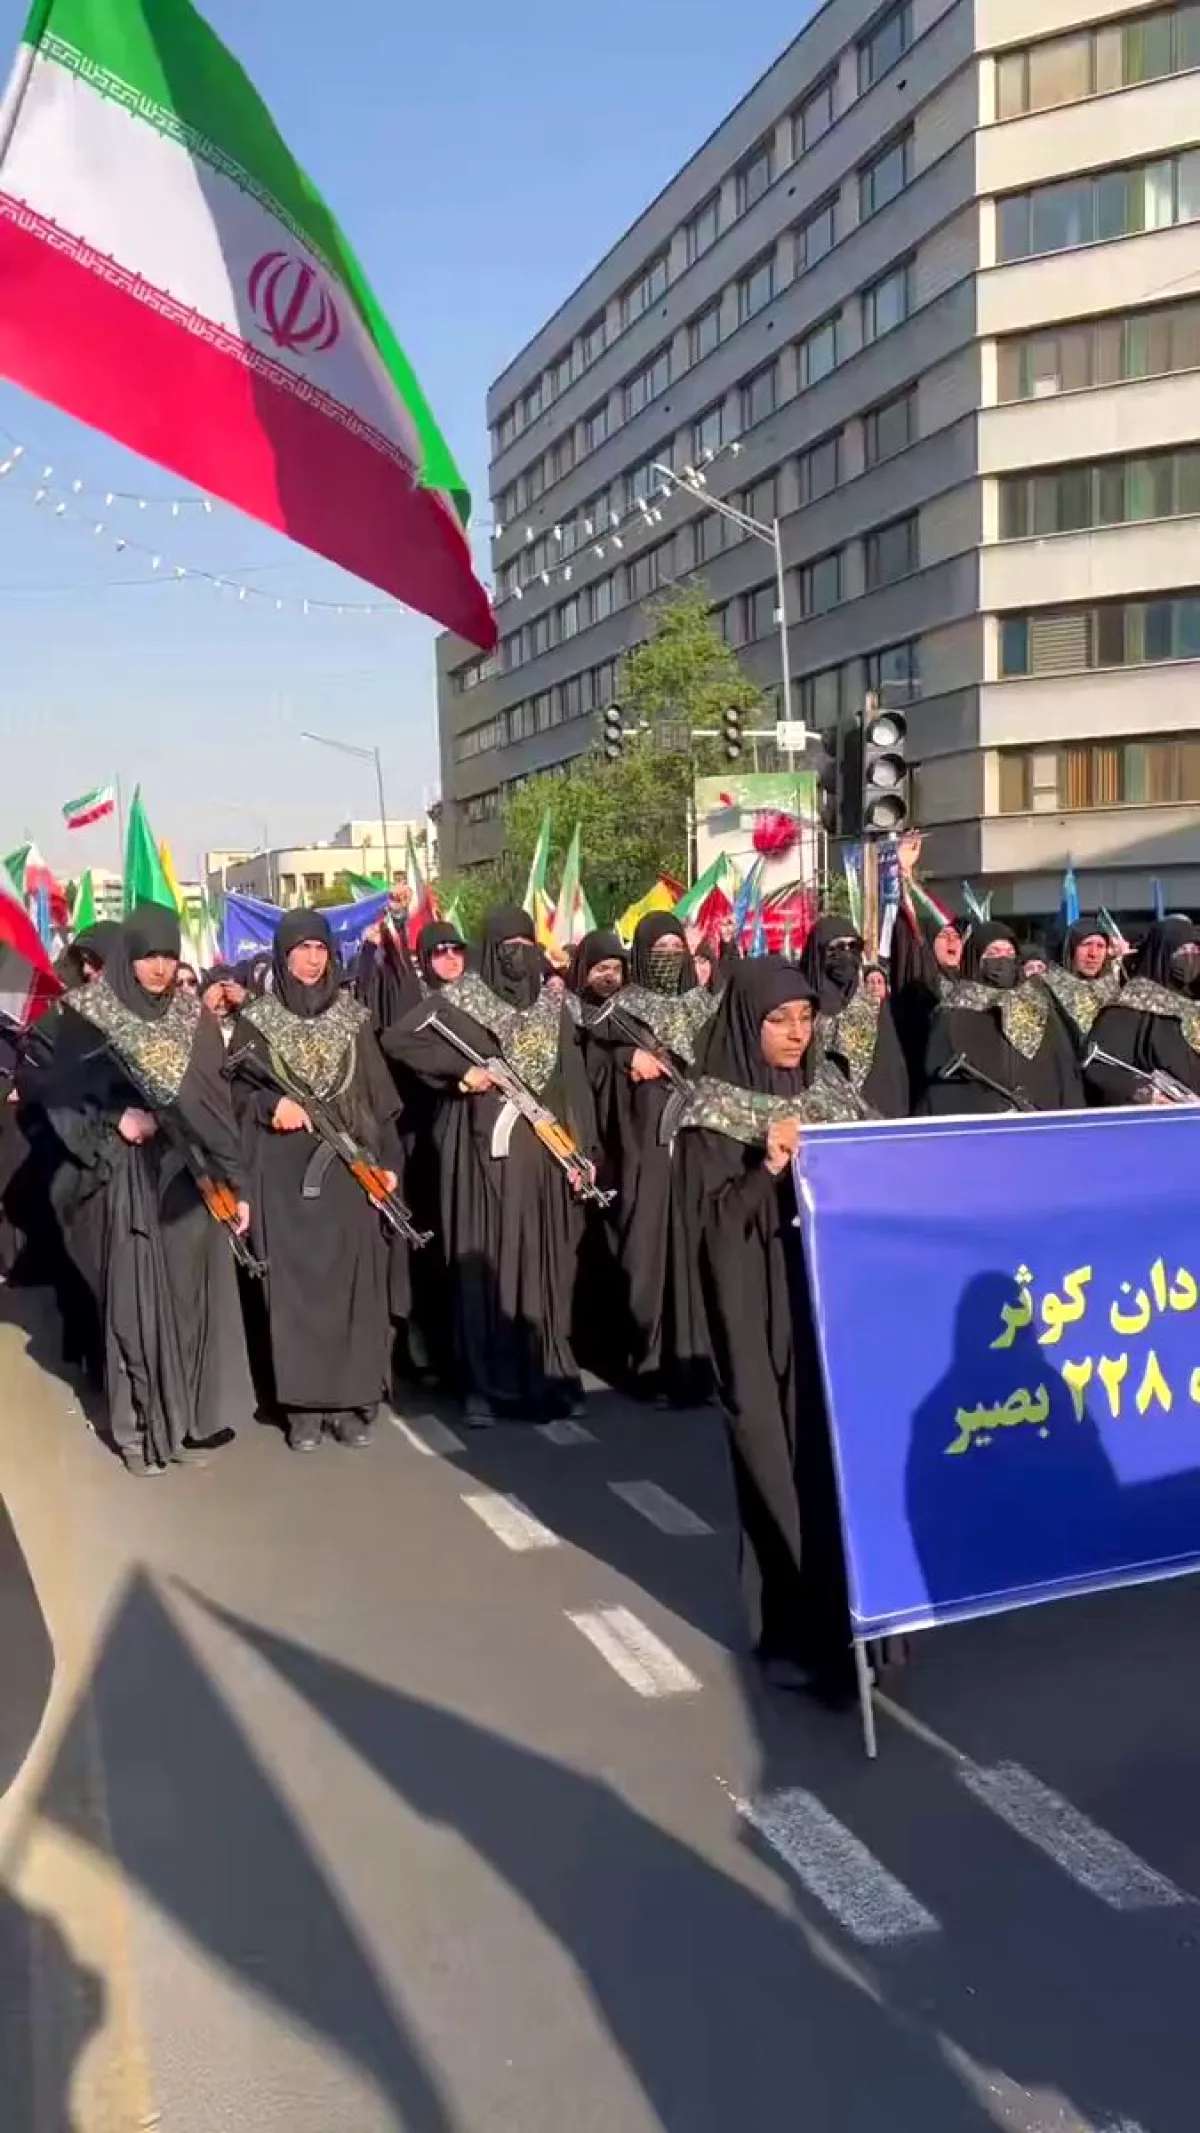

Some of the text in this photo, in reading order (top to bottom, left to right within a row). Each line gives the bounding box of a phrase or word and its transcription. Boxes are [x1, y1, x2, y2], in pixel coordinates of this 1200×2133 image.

[988, 1263, 1093, 1350] کوثر
[944, 1383, 1050, 1456] بصیر
[1061, 1348, 1173, 1423] ۲۲۸
